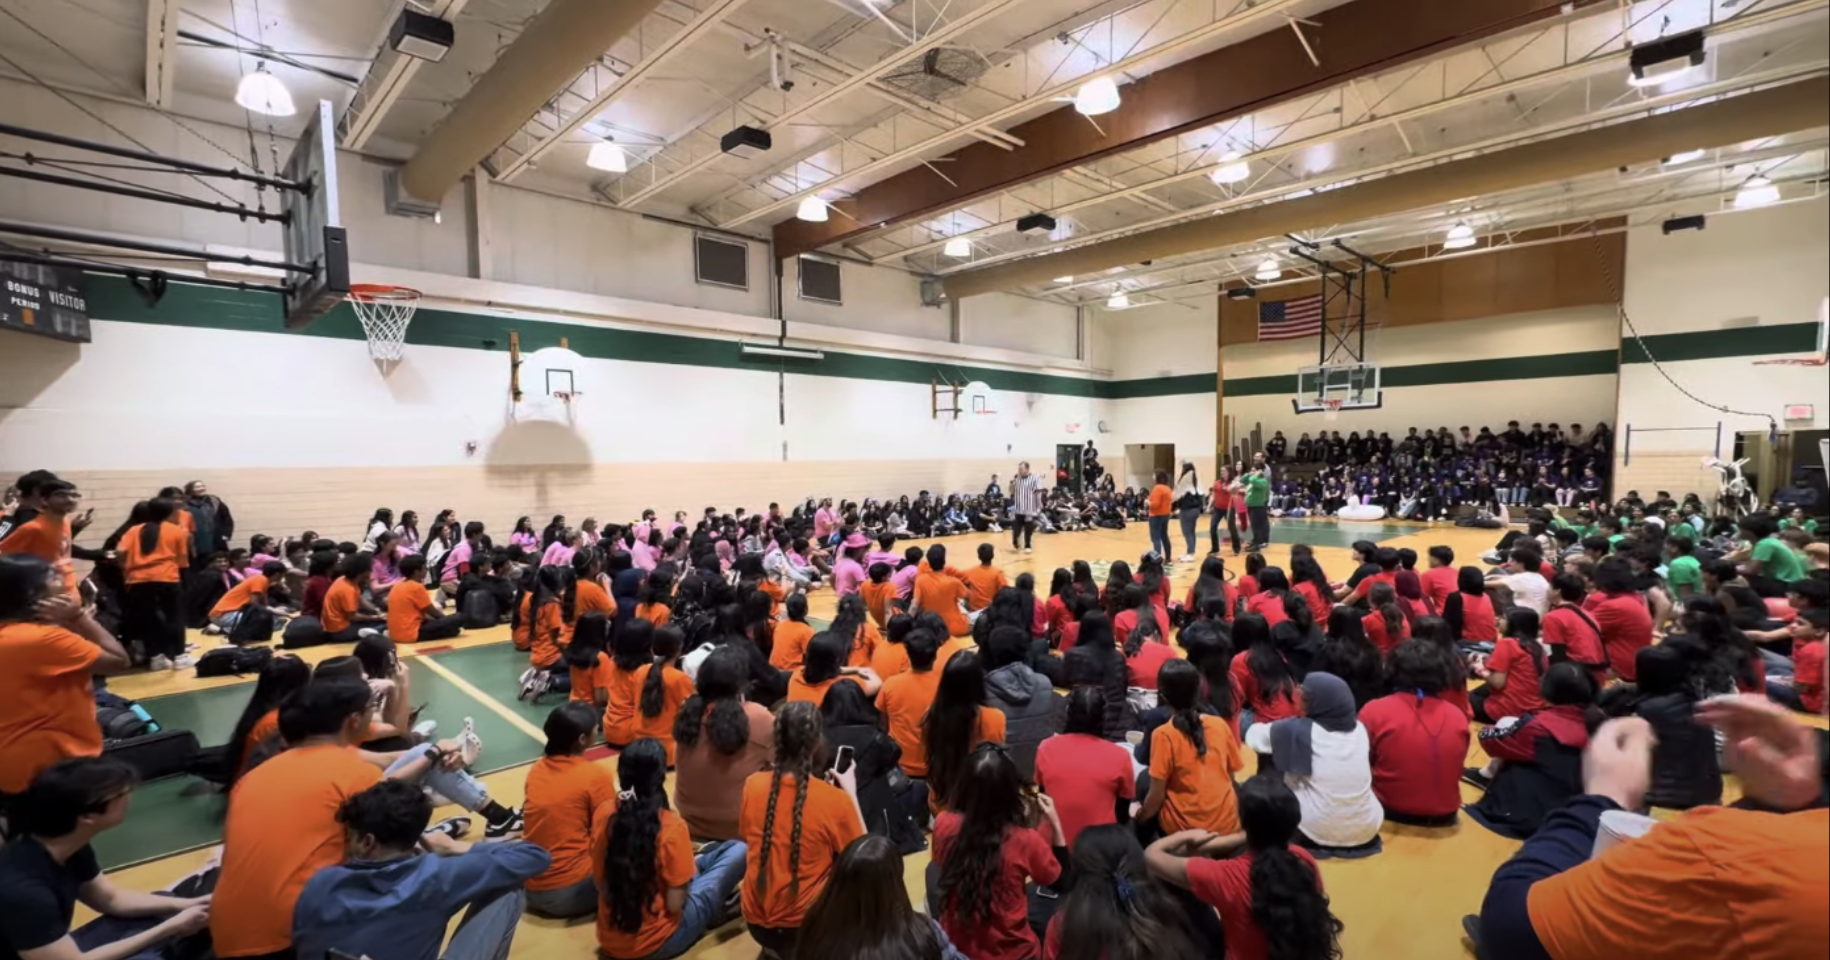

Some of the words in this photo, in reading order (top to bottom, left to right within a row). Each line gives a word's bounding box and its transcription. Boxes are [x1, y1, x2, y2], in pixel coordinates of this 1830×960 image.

[7, 280, 40, 298] BONUS
[11, 296, 40, 310] PERIOD
[48, 290, 86, 311] VISITOR
